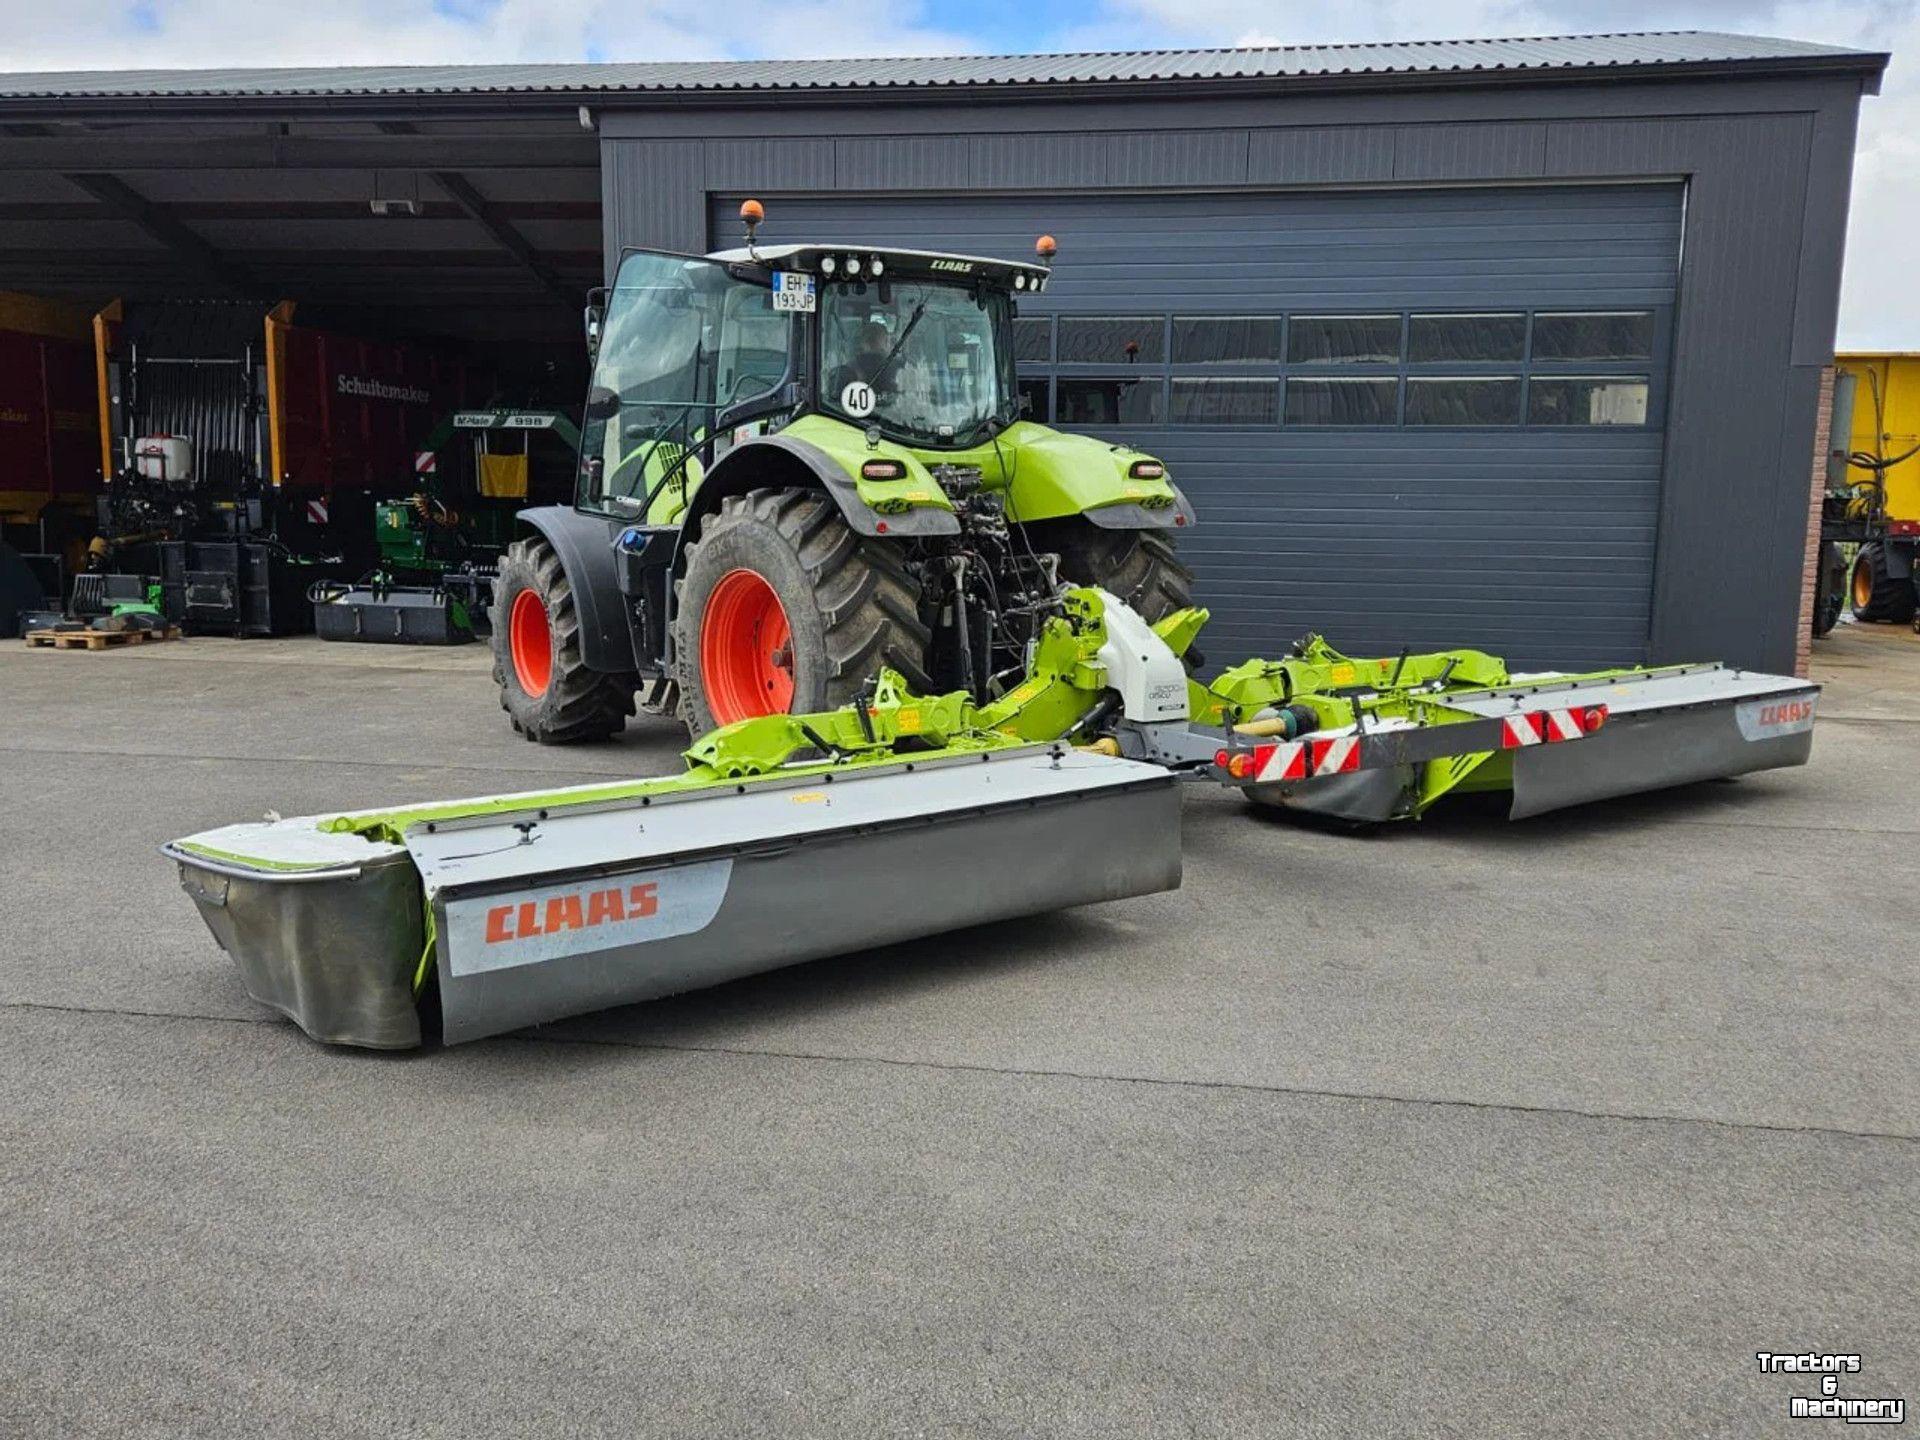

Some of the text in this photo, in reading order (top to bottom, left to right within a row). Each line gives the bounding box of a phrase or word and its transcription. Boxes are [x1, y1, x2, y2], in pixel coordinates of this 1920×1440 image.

[930, 259, 973, 274] CLAAS
[775, 292, 815, 309] 193-JP
[336, 373, 431, 405] Schuitemaker
[848, 388, 869, 411] 40
[514, 417, 542, 426] 998
[1759, 702, 1812, 726] CLAAS
[485, 882, 659, 944] CLAAS
